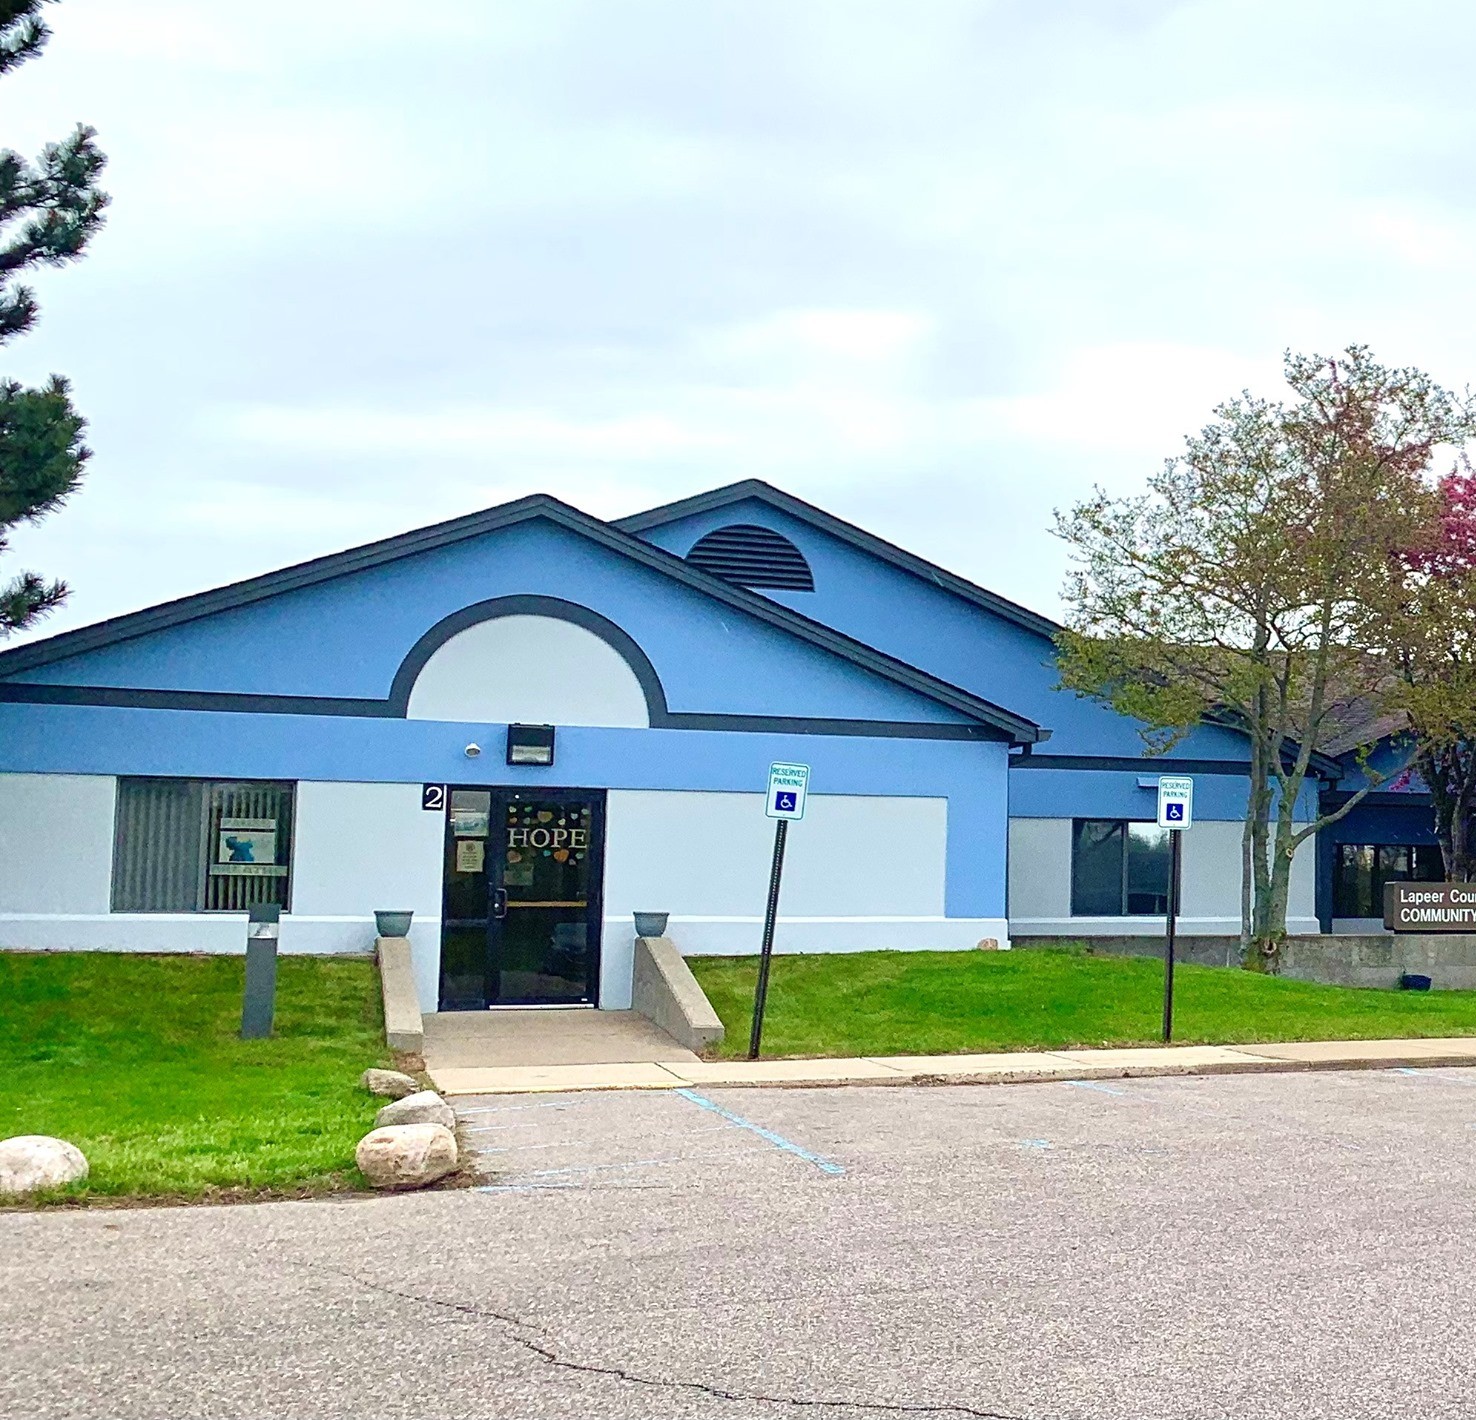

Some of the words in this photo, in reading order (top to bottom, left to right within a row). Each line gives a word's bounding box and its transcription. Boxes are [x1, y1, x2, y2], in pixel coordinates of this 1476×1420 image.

[771, 767, 807, 778] RESERVED
[773, 777, 803, 787] PARKING
[1161, 782, 1190, 790] RESERVED
[425, 786, 443, 808] 2
[1163, 790, 1187, 798] PARKING
[507, 827, 587, 849] HOPE
[1400, 889, 1444, 905] Lapeer
